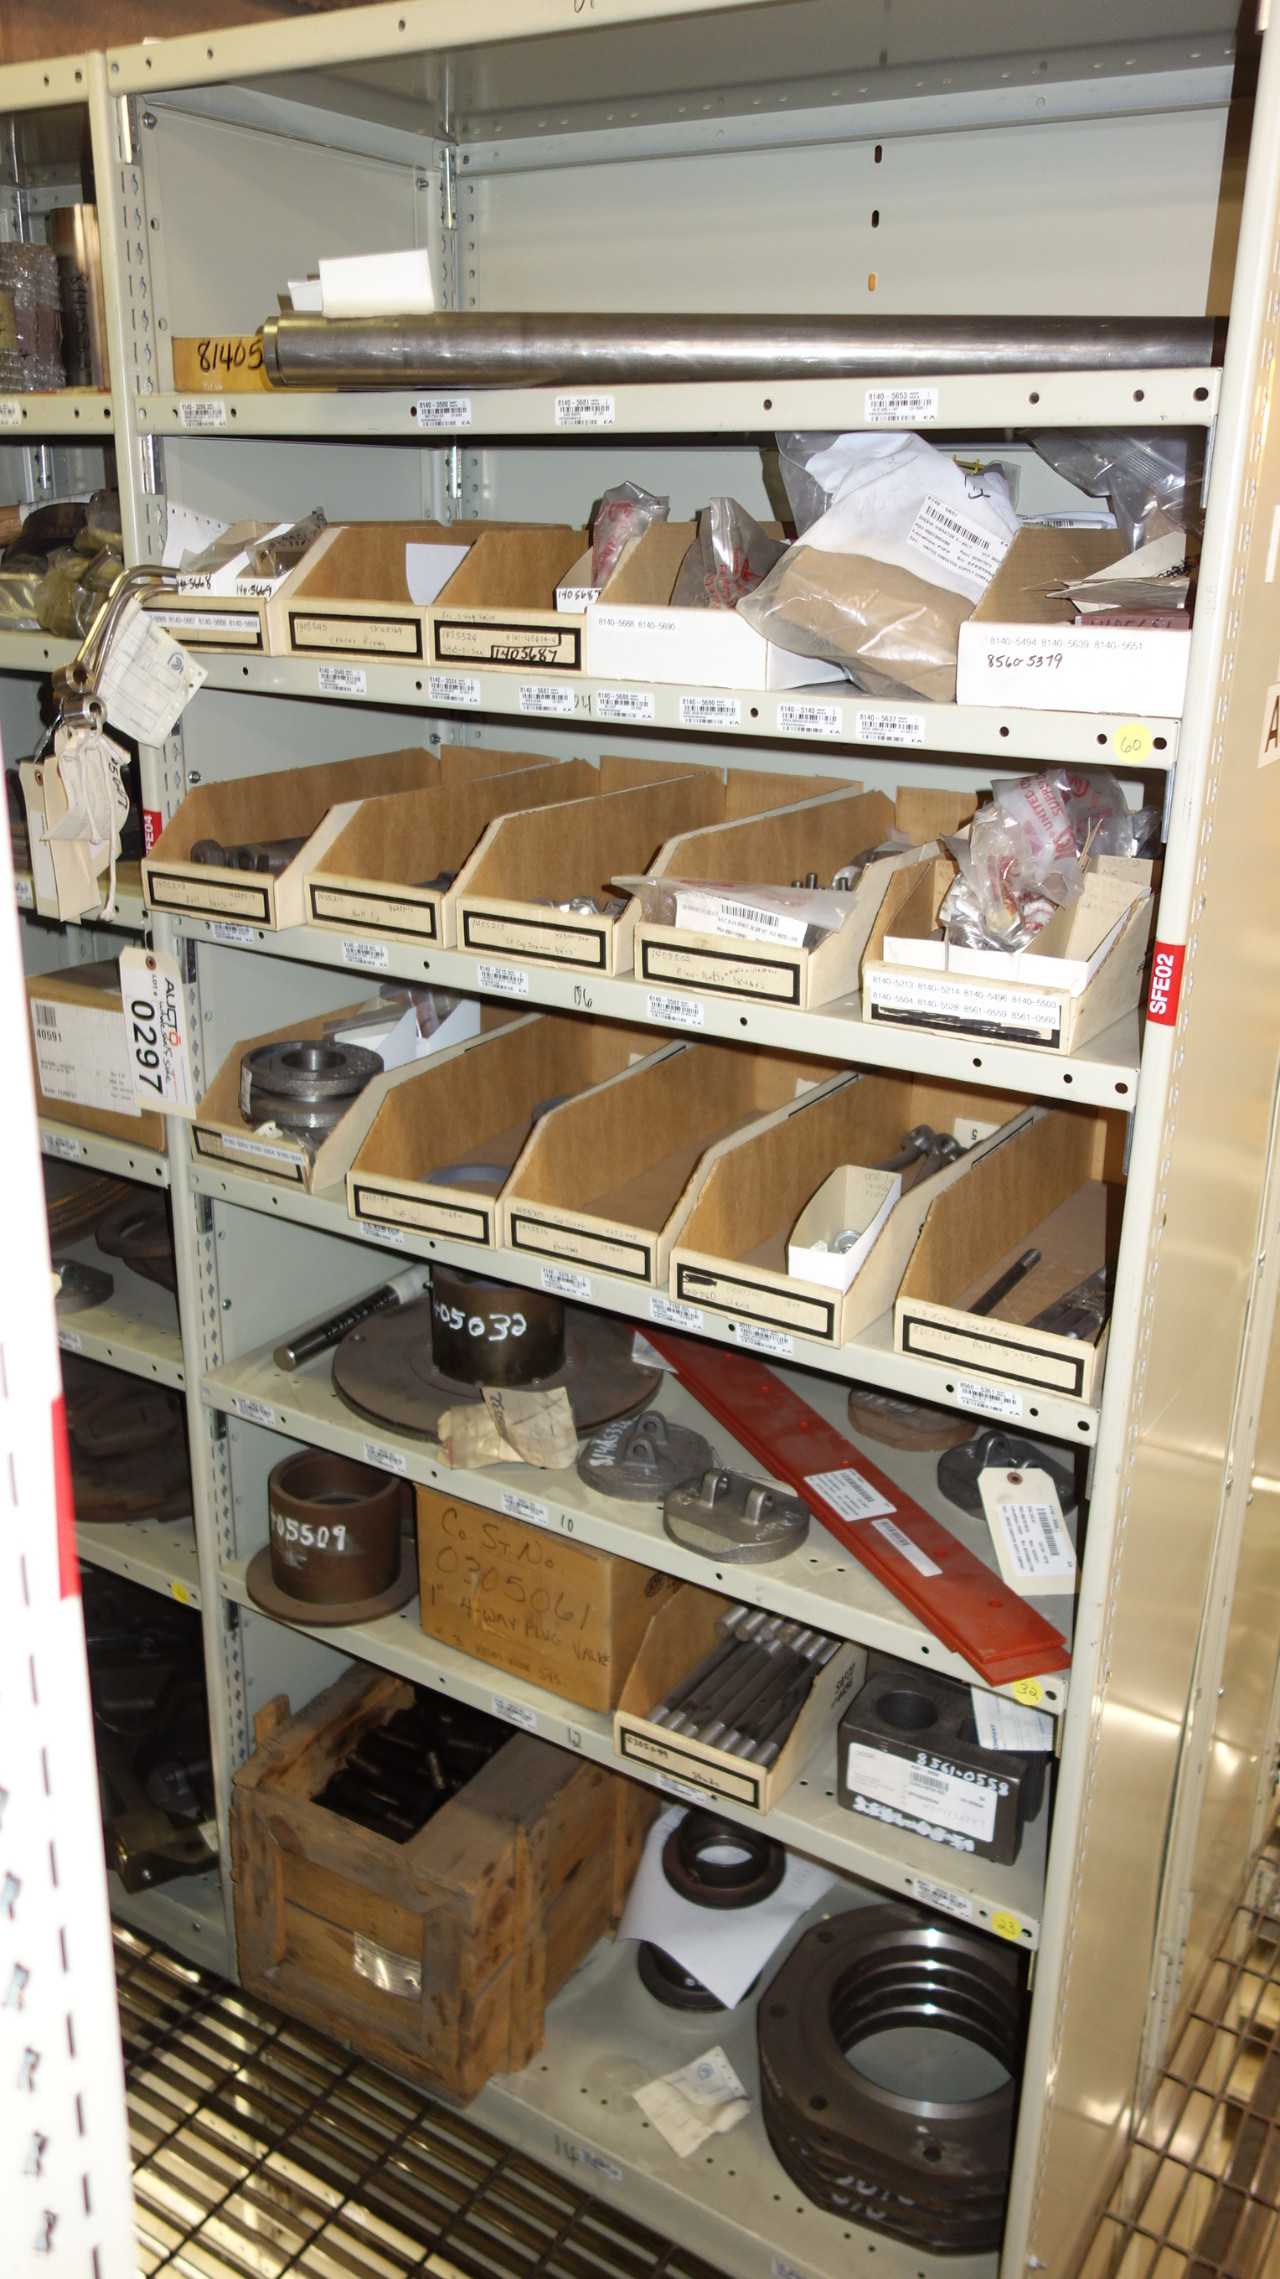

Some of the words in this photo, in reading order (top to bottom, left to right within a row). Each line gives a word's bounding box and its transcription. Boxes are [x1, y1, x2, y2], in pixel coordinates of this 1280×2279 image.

[1119, 735, 1142, 753] 60
[1149, 953, 1175, 1015] SFE02
[131, 1000, 163, 1095] 0297
[270, 1514, 347, 1553] 05509
